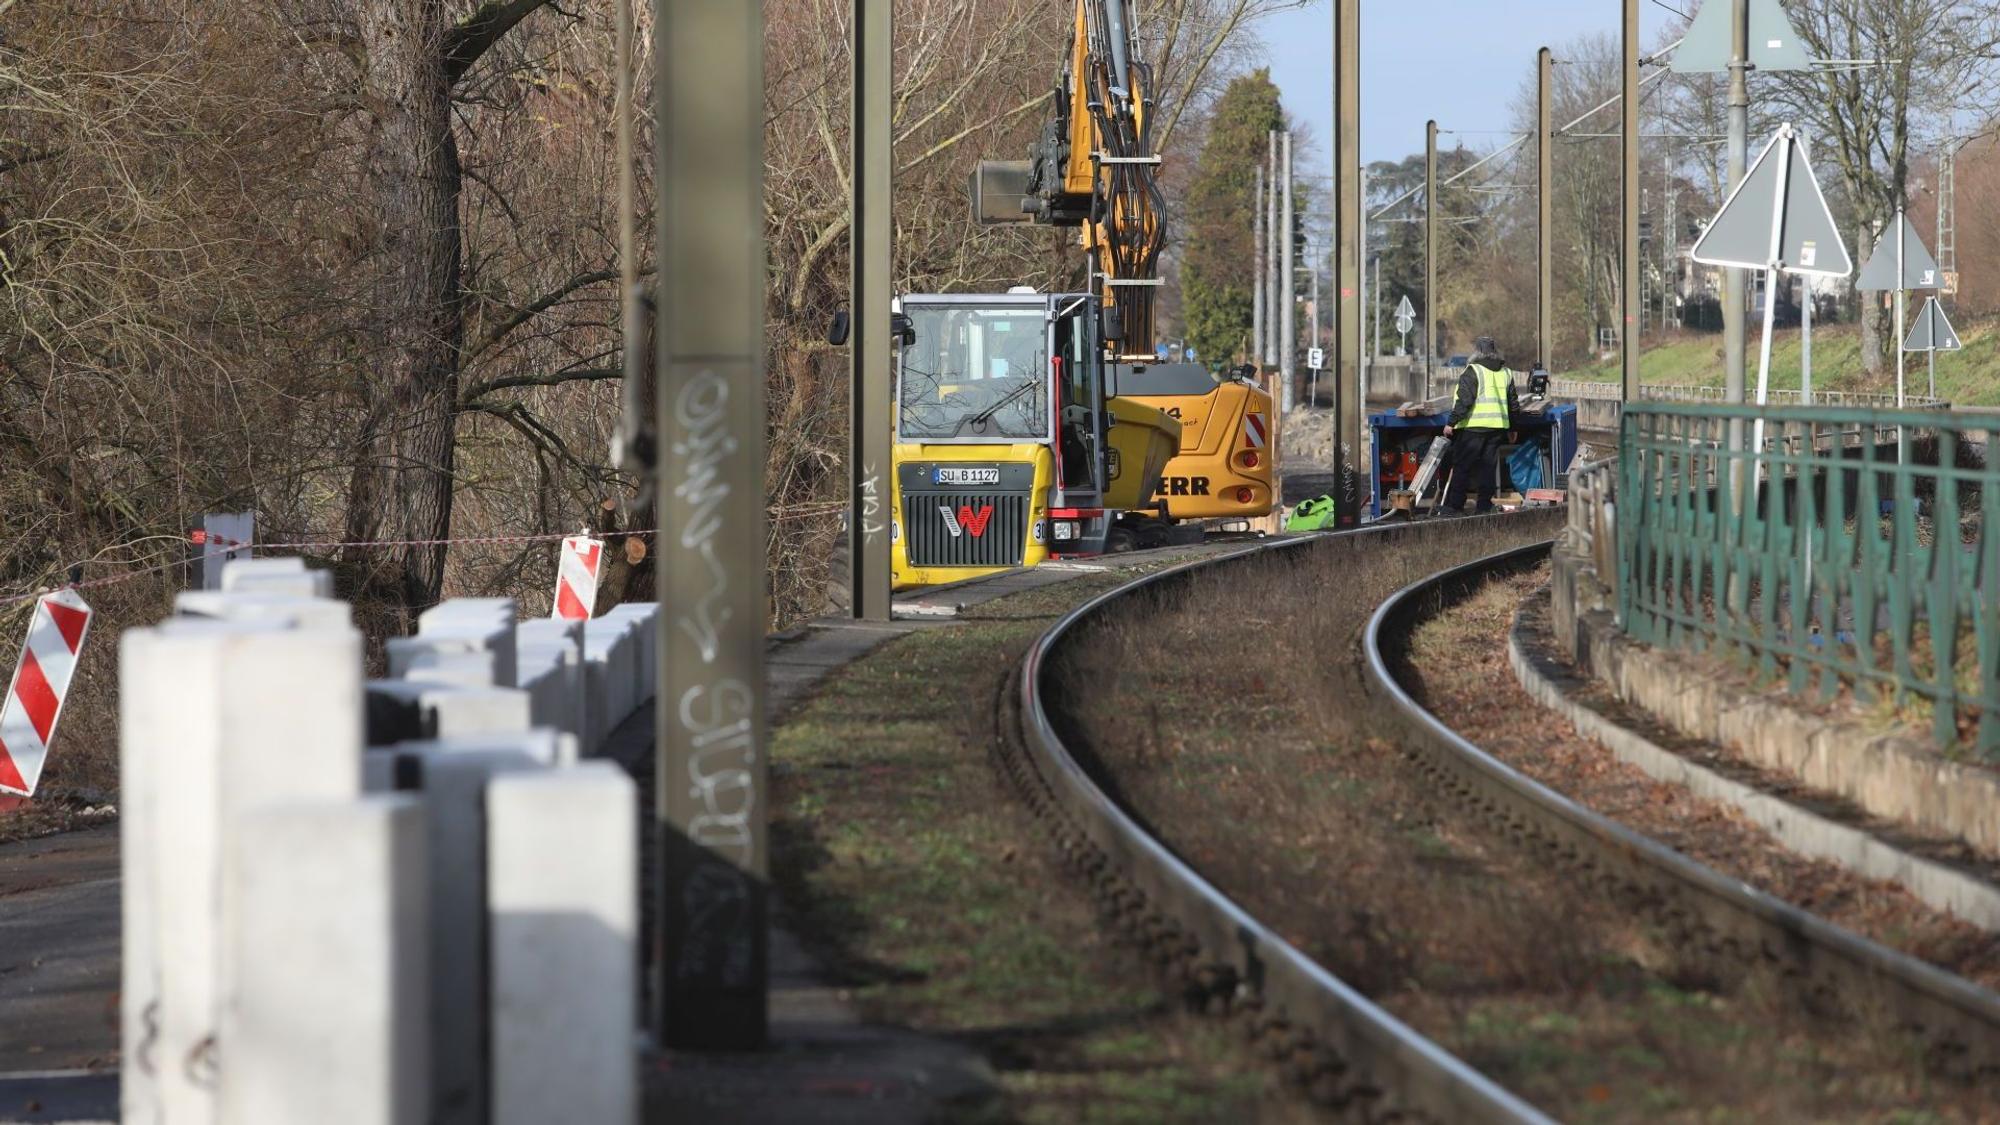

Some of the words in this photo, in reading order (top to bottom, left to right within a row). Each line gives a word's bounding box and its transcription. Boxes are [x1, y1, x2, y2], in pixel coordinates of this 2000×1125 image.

[1311, 350, 1320, 366] E
[940, 470, 955, 481] SU
[961, 470, 969, 481] B
[971, 470, 998, 481] 1127
